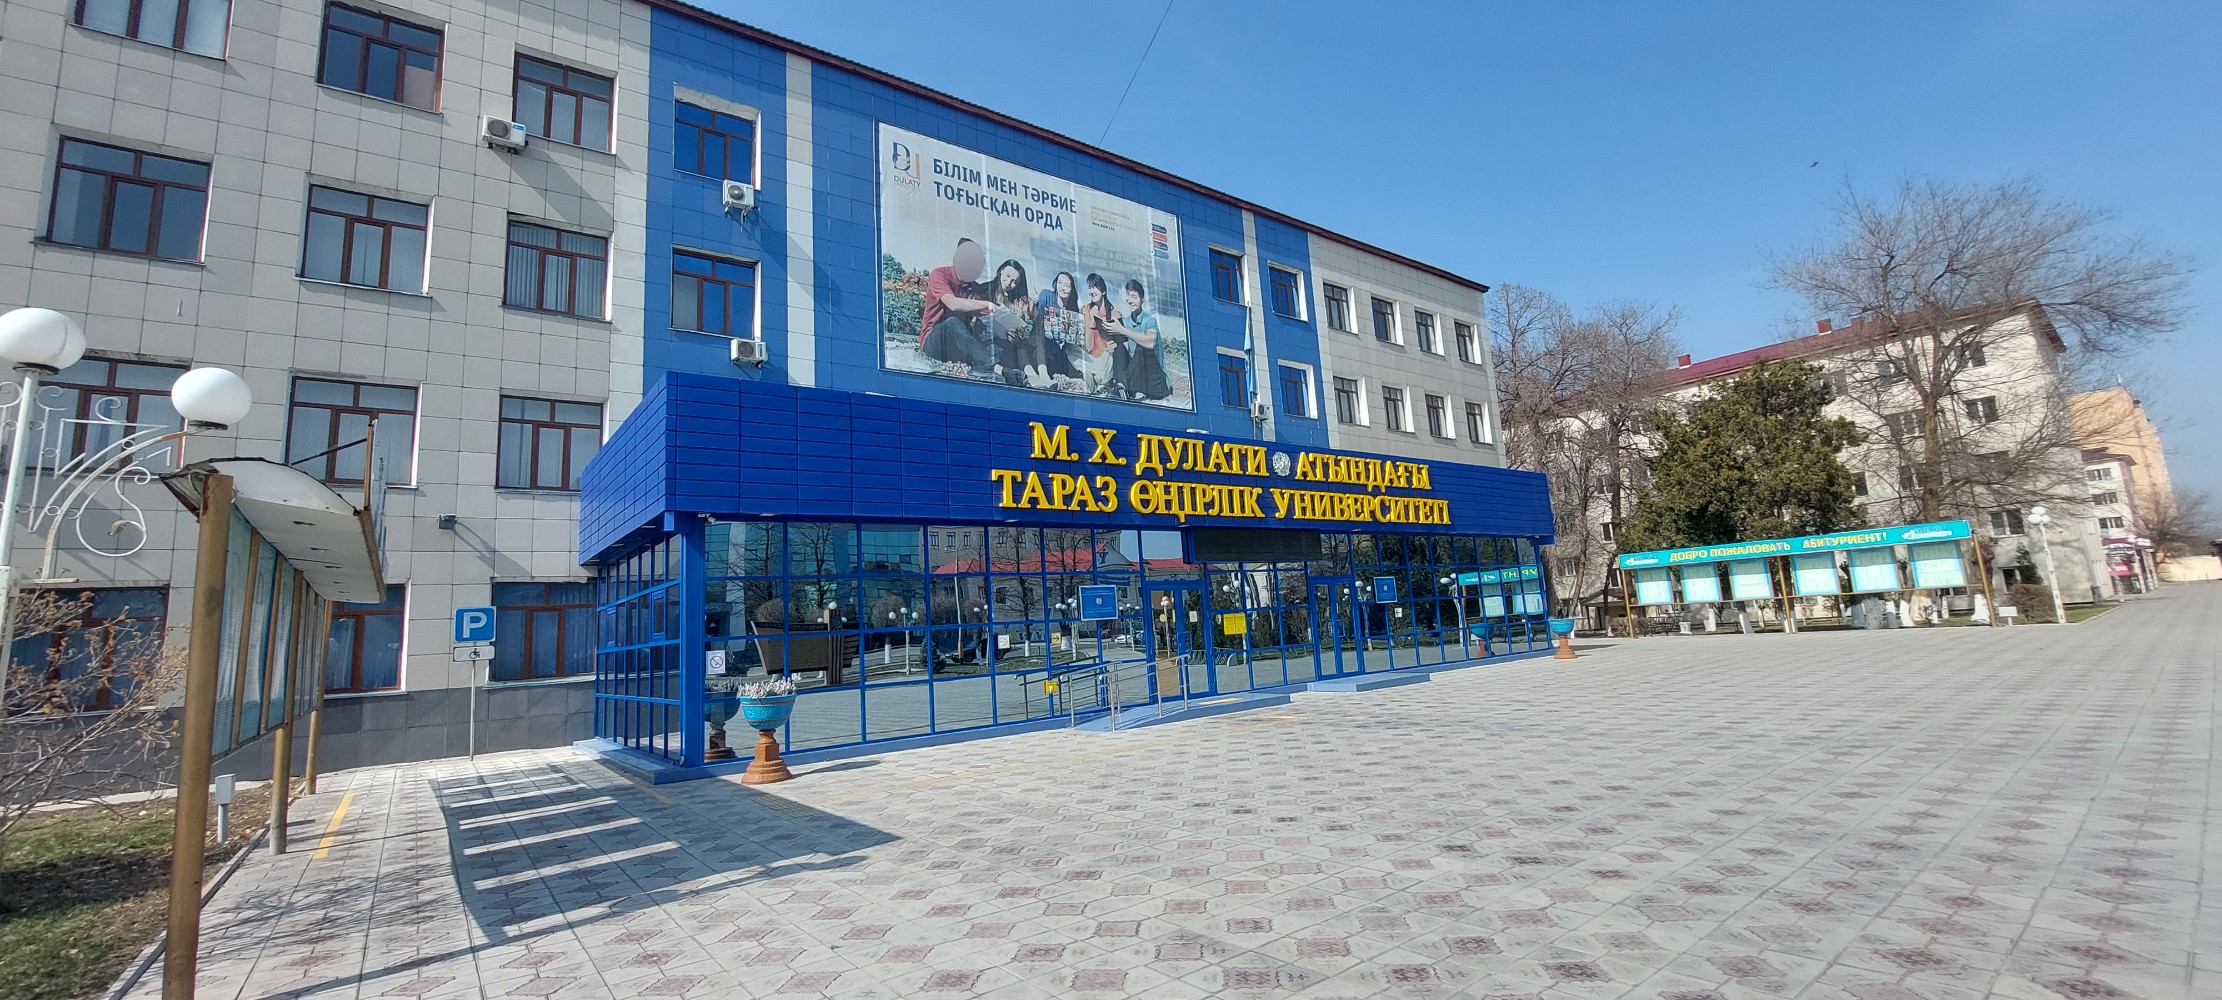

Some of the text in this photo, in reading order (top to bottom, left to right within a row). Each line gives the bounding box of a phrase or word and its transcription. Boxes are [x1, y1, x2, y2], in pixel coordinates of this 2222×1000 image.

[893, 175, 921, 188] DULATY
[933, 157, 982, 187] БІЛІМ
[986, 173, 1018, 197] МЕН
[1021, 184, 1077, 214] ТӘРБИЕ
[933, 180, 1020, 219] ТОҒЫСҚАН
[1024, 206, 1064, 231] ОРДА
[1028, 421, 1432, 493] М. Х. ДУЛАТИ АТЫНДАҒЫ
[991, 469, 1452, 525] ТАРАЗ ӨҢІРЛІК УНИВЕРСИТЕТІ
[1669, 549, 1708, 563] ДОБРО
[1709, 541, 1791, 558] ПОЖАЛОВАТЬ
[1802, 531, 1888, 549] АБИТУРИЕНТ!
[462, 611, 488, 639] P
